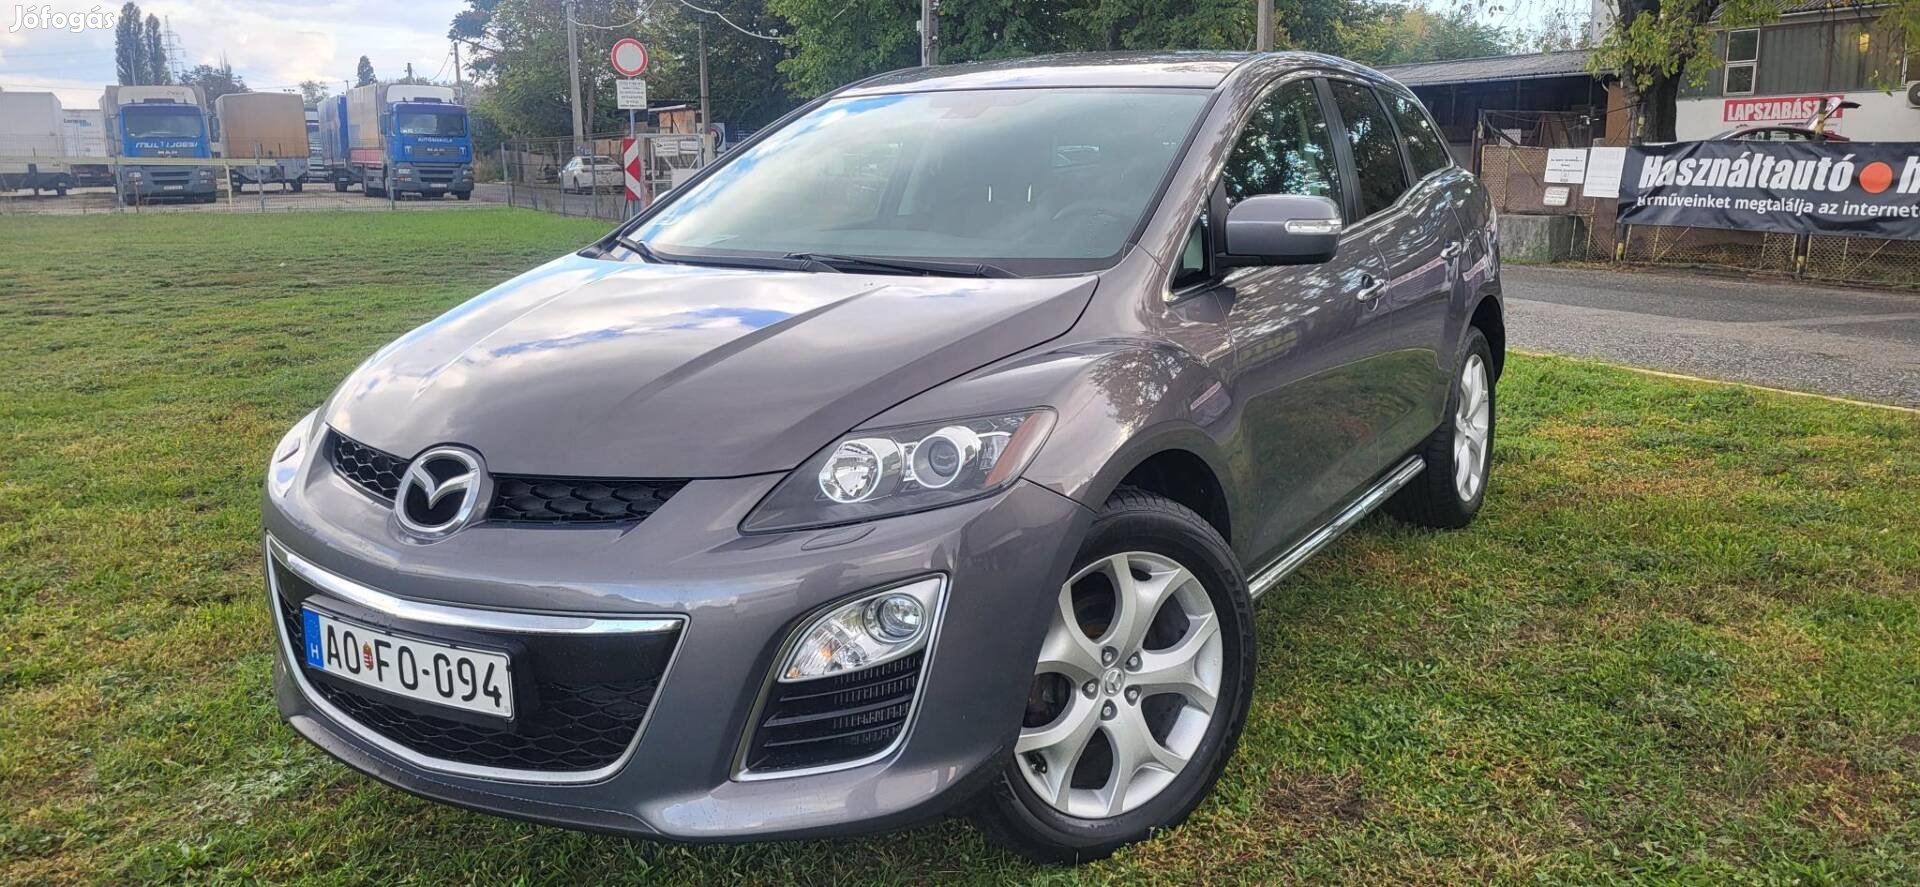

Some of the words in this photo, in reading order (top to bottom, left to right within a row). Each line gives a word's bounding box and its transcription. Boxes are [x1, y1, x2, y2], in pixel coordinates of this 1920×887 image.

[1727, 98, 1838, 121] LAPSZABÁSZ
[1638, 151, 1856, 192] Használtautó
[1734, 196, 1814, 217] megtalálja
[1818, 202, 1839, 215] az
[1842, 201, 1920, 218] internet
[310, 646, 320, 660] H
[373, 638, 503, 708] FO-094
